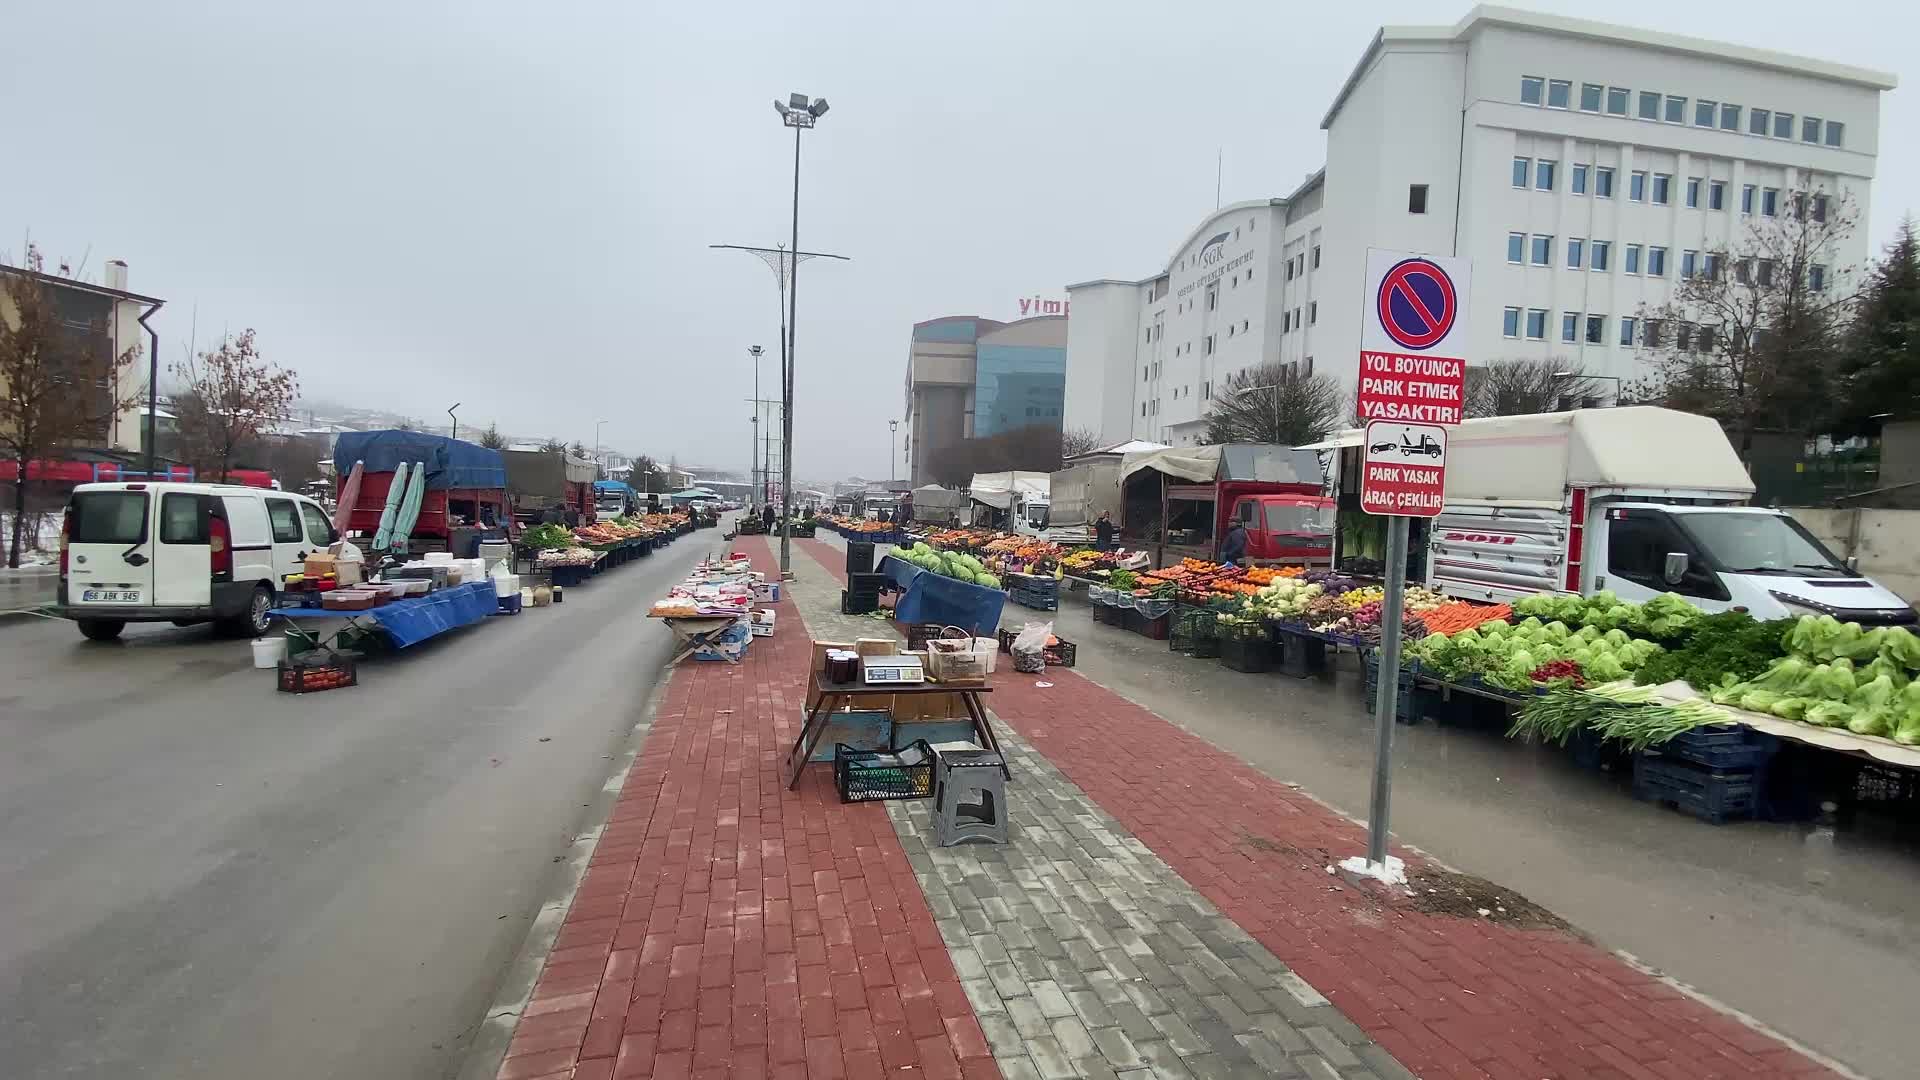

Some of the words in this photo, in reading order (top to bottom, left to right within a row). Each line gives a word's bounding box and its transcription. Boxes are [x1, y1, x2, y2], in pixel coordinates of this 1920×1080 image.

[1203, 244, 1225, 266] SGK
[1365, 354, 1392, 372] YOL
[1394, 357, 1461, 378] BOYUNCA
[1362, 377, 1404, 396] PARK
[1407, 381, 1460, 400] ETMEK
[1361, 400, 1460, 423] YASAKTIR!
[1369, 467, 1401, 482] PARK
[1402, 468, 1440, 485] YASAK
[1363, 490, 1395, 508] ARAÇ
[1397, 490, 1442, 509] ÇEKİLİR
[1444, 532, 1518, 545] 2011
